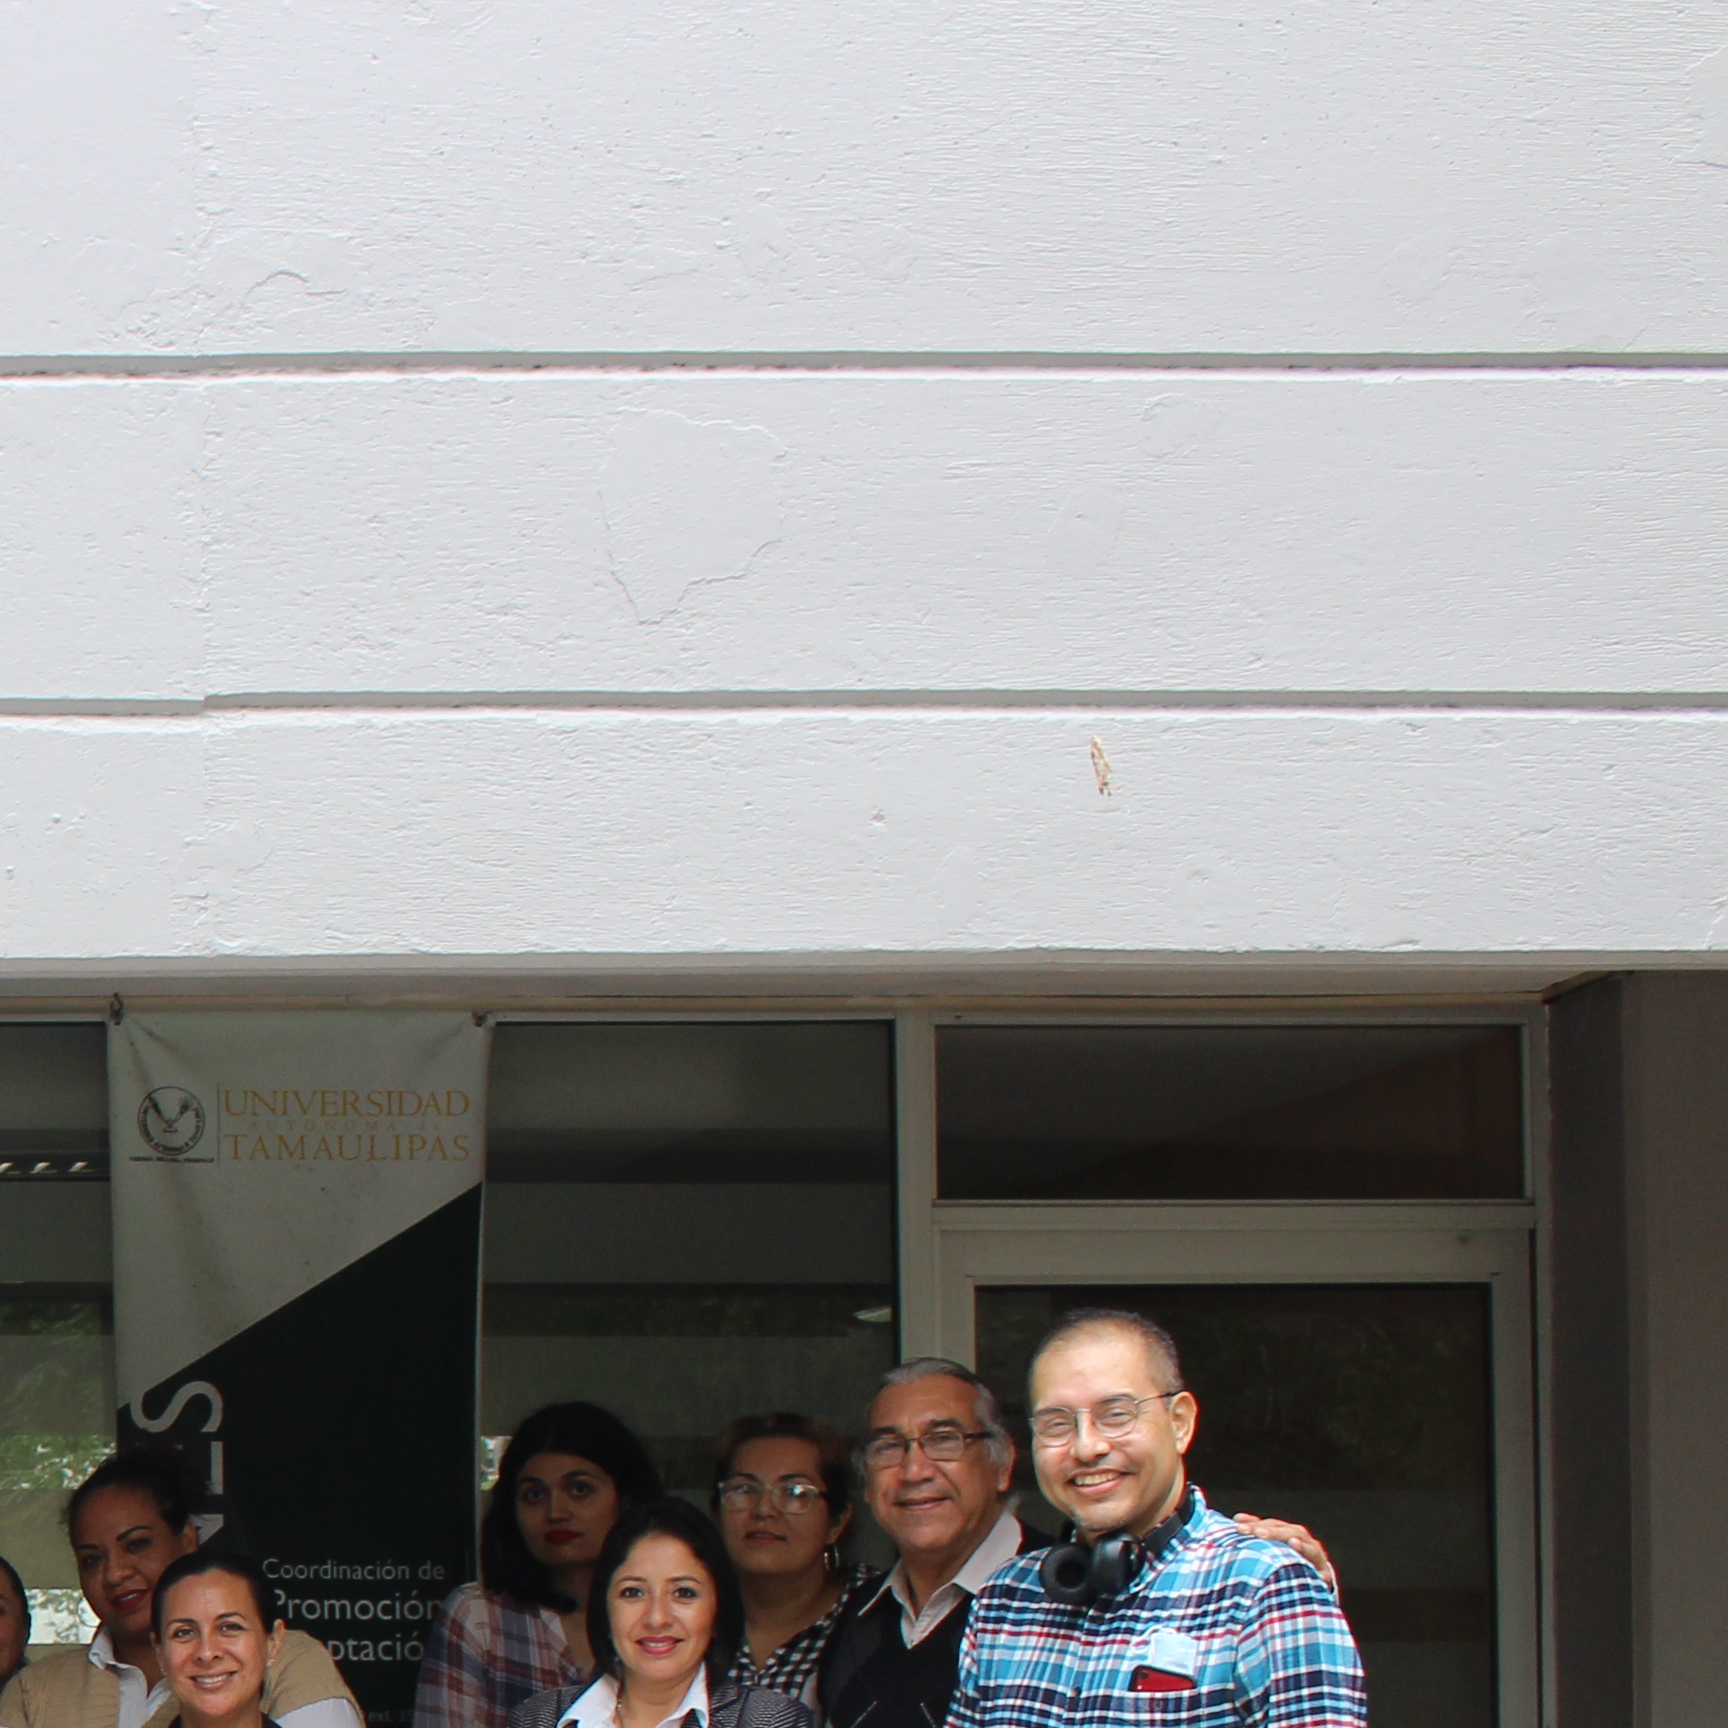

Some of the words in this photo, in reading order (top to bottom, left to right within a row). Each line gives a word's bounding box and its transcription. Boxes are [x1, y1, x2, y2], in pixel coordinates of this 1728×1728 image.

[223, 1089, 470, 1118] UNIVERSIDAD
[223, 1133, 470, 1161] TAMAULIPAS
[262, 1557, 410, 1580] Coordinación
[417, 1559, 445, 1580] de
